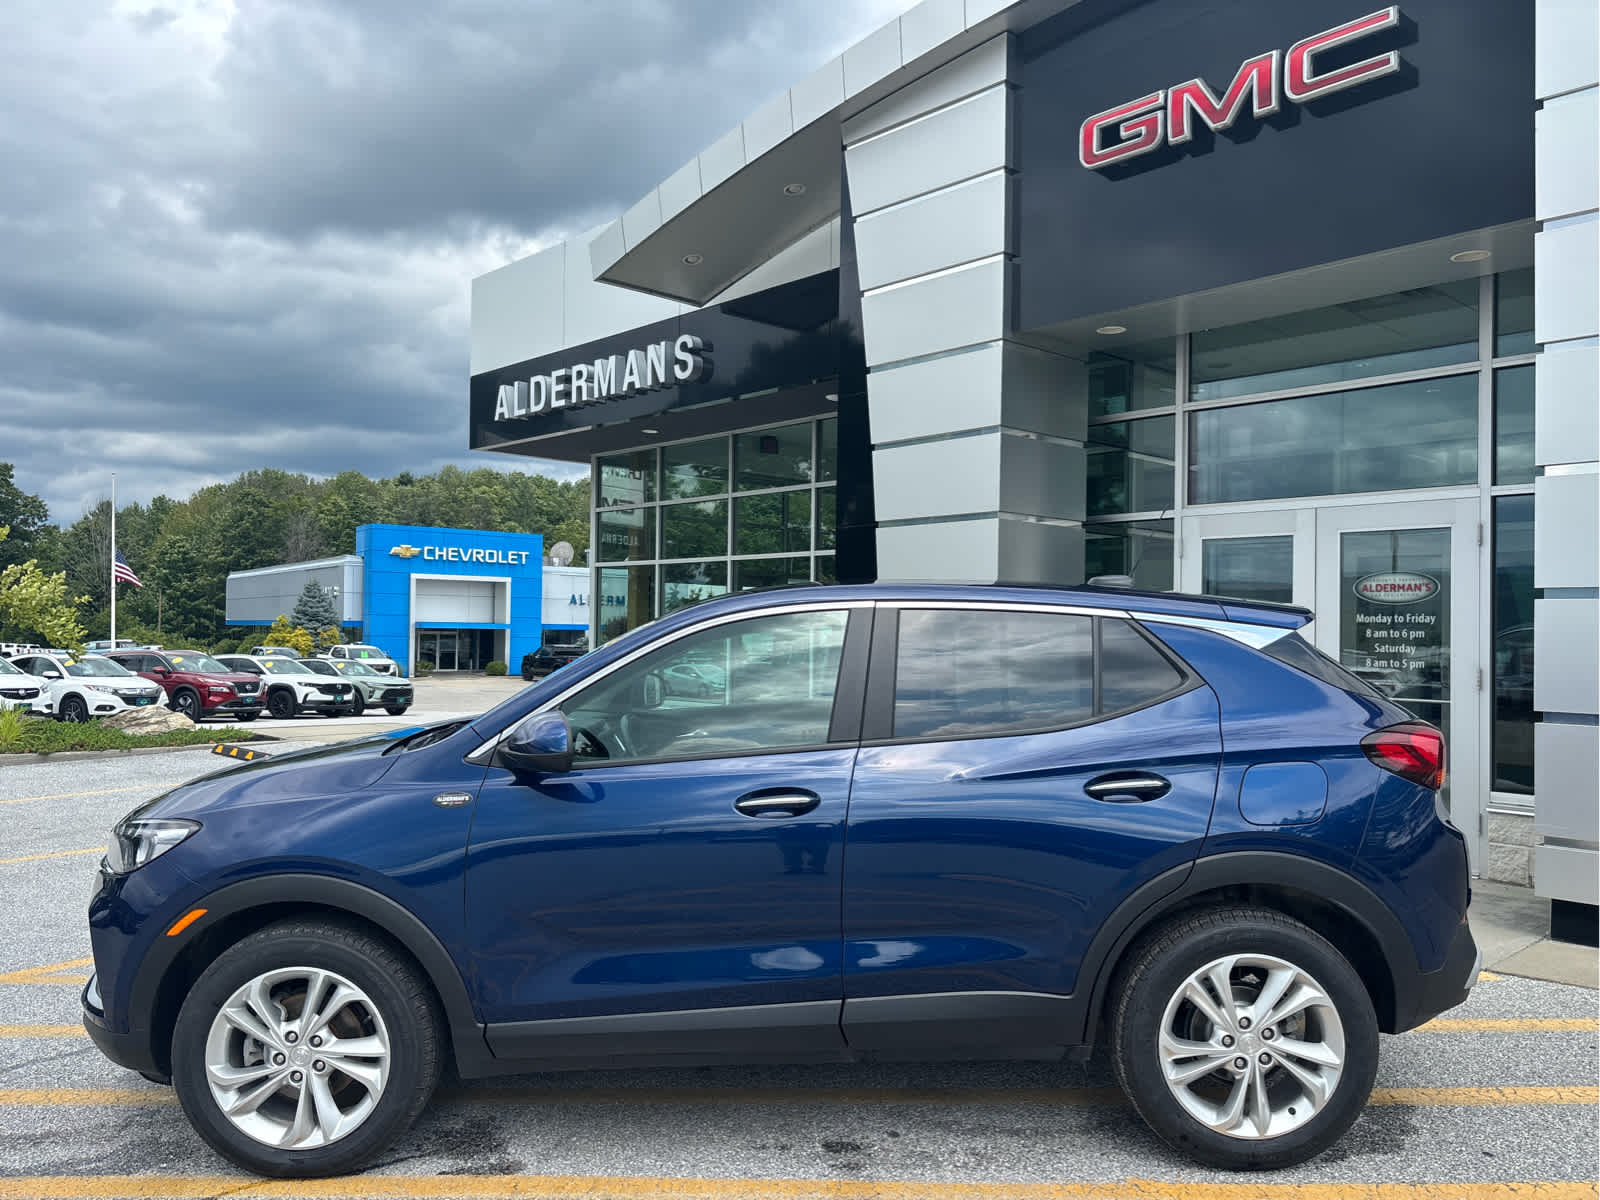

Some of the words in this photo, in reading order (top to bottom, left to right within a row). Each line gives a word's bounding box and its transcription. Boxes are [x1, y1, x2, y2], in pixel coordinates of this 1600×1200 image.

[1079, 5, 1401, 170] GMC
[494, 334, 704, 421] ALDERMANS
[423, 546, 529, 565] CHEVROLET
[1361, 583, 1432, 592] ALDERMAN'S
[1356, 613, 1392, 624] Monday
[1394, 614, 1404, 623] to
[1406, 613, 1436, 625] Friday
[1366, 629, 1372, 638] 8
[1373, 630, 1388, 638] am
[1390, 629, 1400, 638] to
[1402, 629, 1408, 638] 6
[1410, 630, 1425, 640] pm
[1374, 643, 1416, 655] Saturday
[1366, 658, 1372, 668] 8
[1373, 660, 1388, 668] am
[1390, 659, 1400, 668] to
[1402, 660, 1408, 668] 5
[1410, 661, 1425, 671] pm
